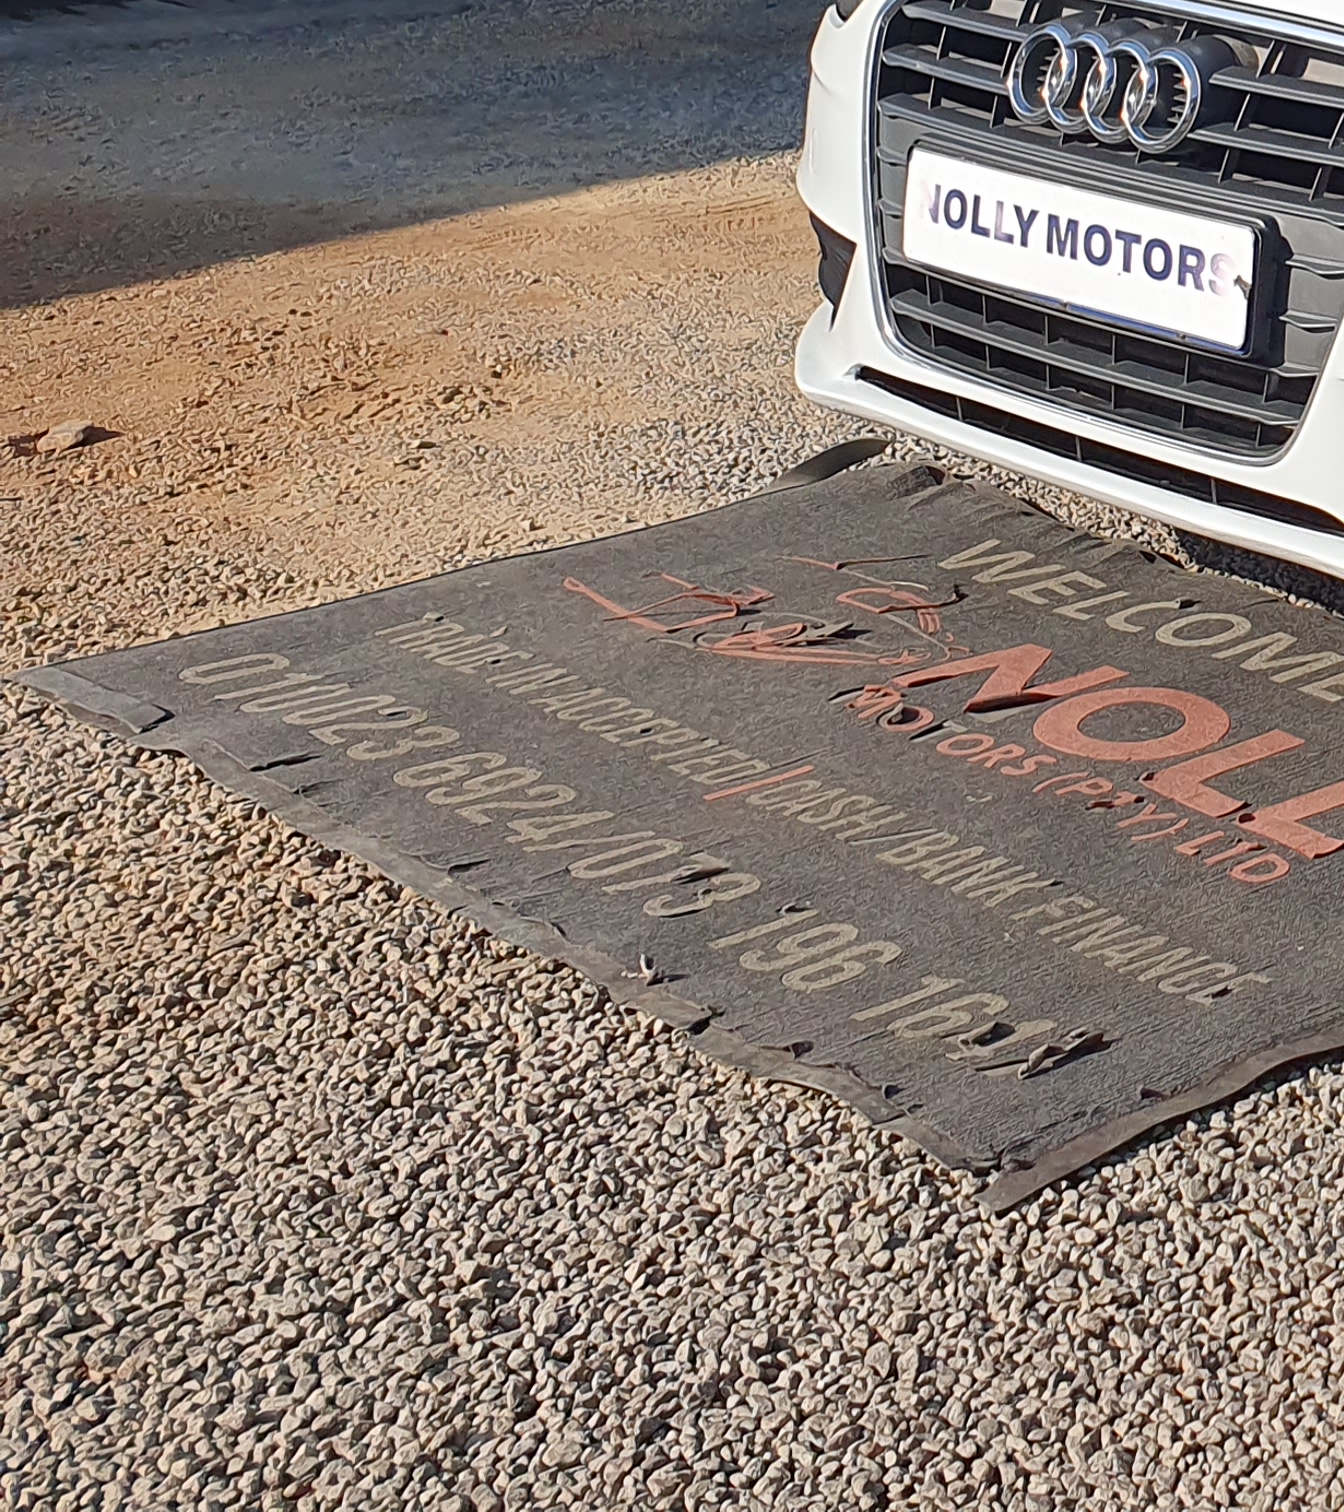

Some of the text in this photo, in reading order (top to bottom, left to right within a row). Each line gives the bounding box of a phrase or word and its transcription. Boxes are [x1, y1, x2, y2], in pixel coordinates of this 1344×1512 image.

[1045, 212, 1238, 298] MOTORS
[829, 684, 1057, 776] MOTORS
[375, 612, 535, 674] TRADE
[485, 663, 580, 696] IN
[1010, 894, 1272, 1007] FINANCE
[706, 900, 904, 993] 196
